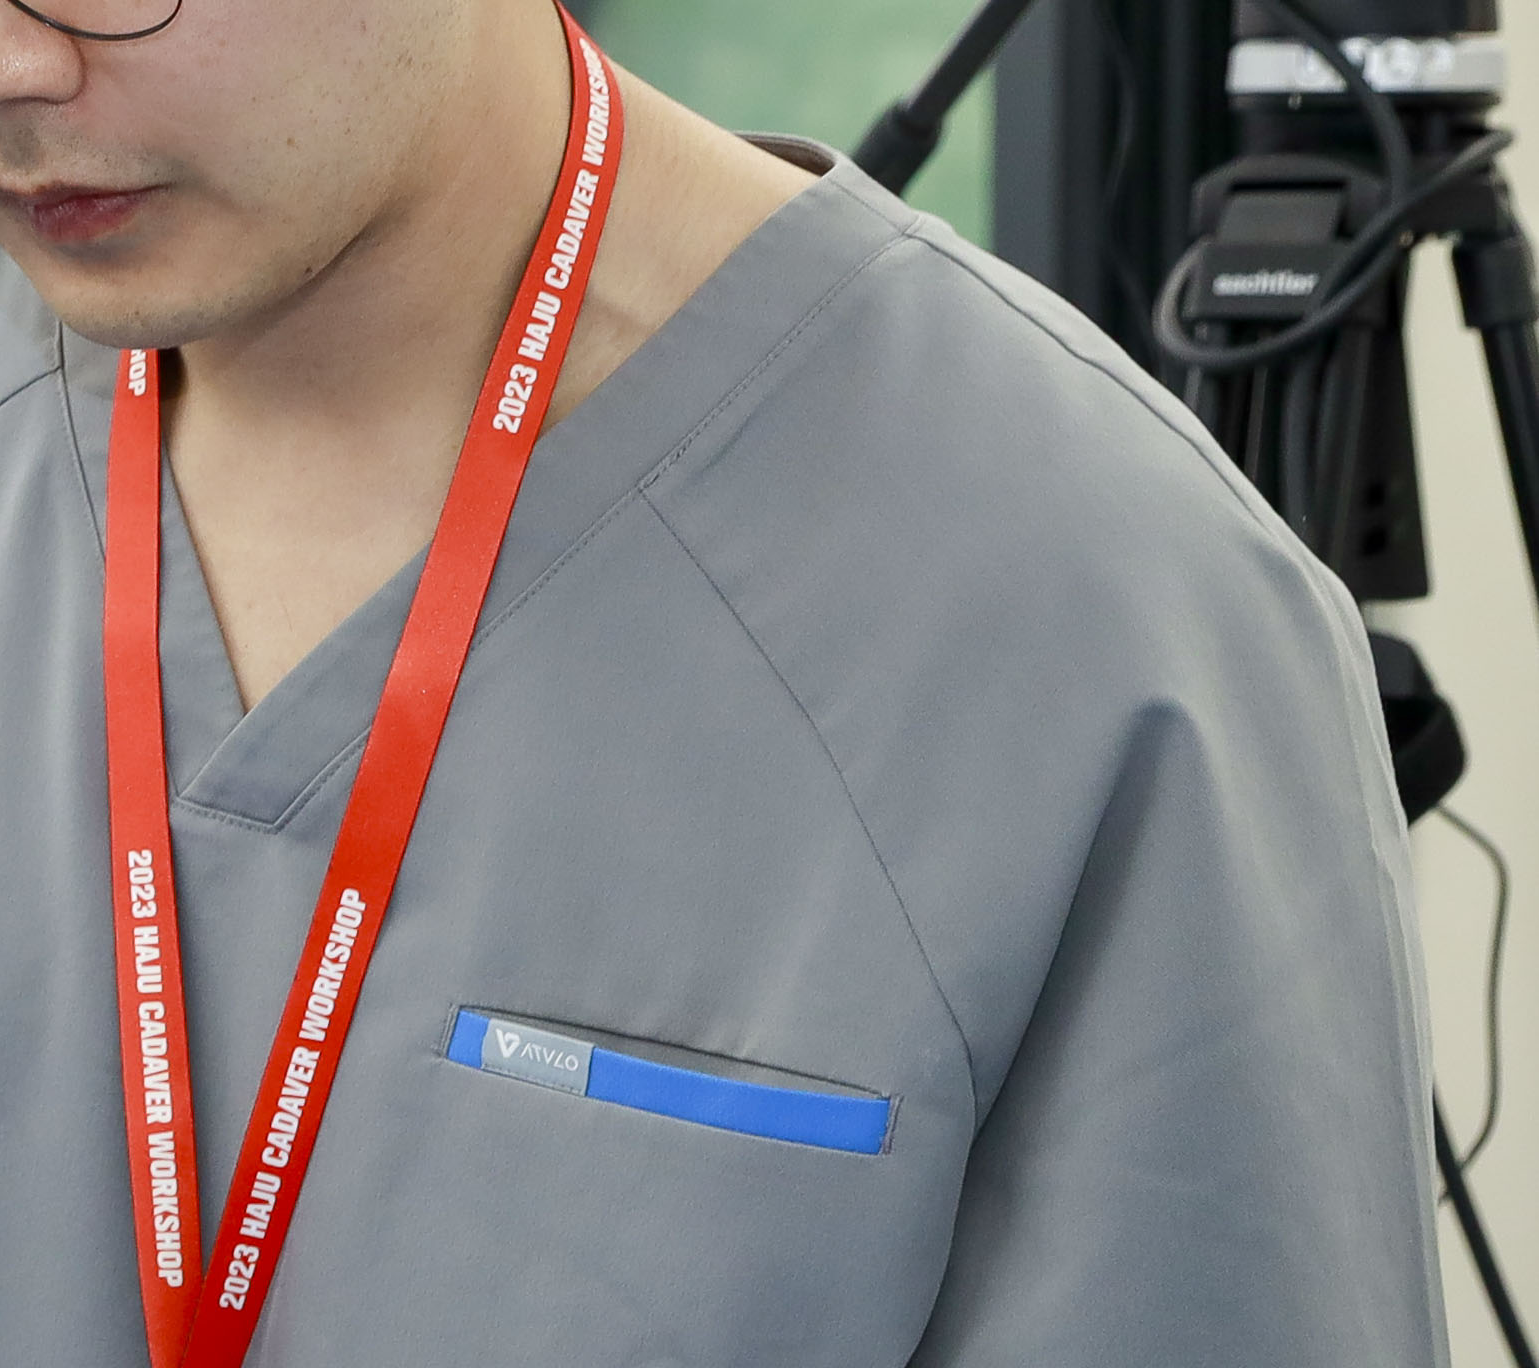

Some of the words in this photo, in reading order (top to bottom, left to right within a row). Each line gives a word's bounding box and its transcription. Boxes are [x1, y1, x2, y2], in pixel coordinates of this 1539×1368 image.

[492, 363, 539, 434] 2023
[517, 291, 562, 362] HAJU
[543, 168, 601, 291] CADAVER
[127, 848, 157, 919] 2023
[133, 924, 164, 995] HAJU
[298, 887, 368, 1044] WORKSHOP
[137, 1000, 174, 1126] CADAVER
[261, 1045, 321, 1169] CADAVER
[148, 1130, 184, 1289] WORKSHOP
[239, 1171, 283, 1241] HAJU
[218, 1245, 261, 1312] 2023
